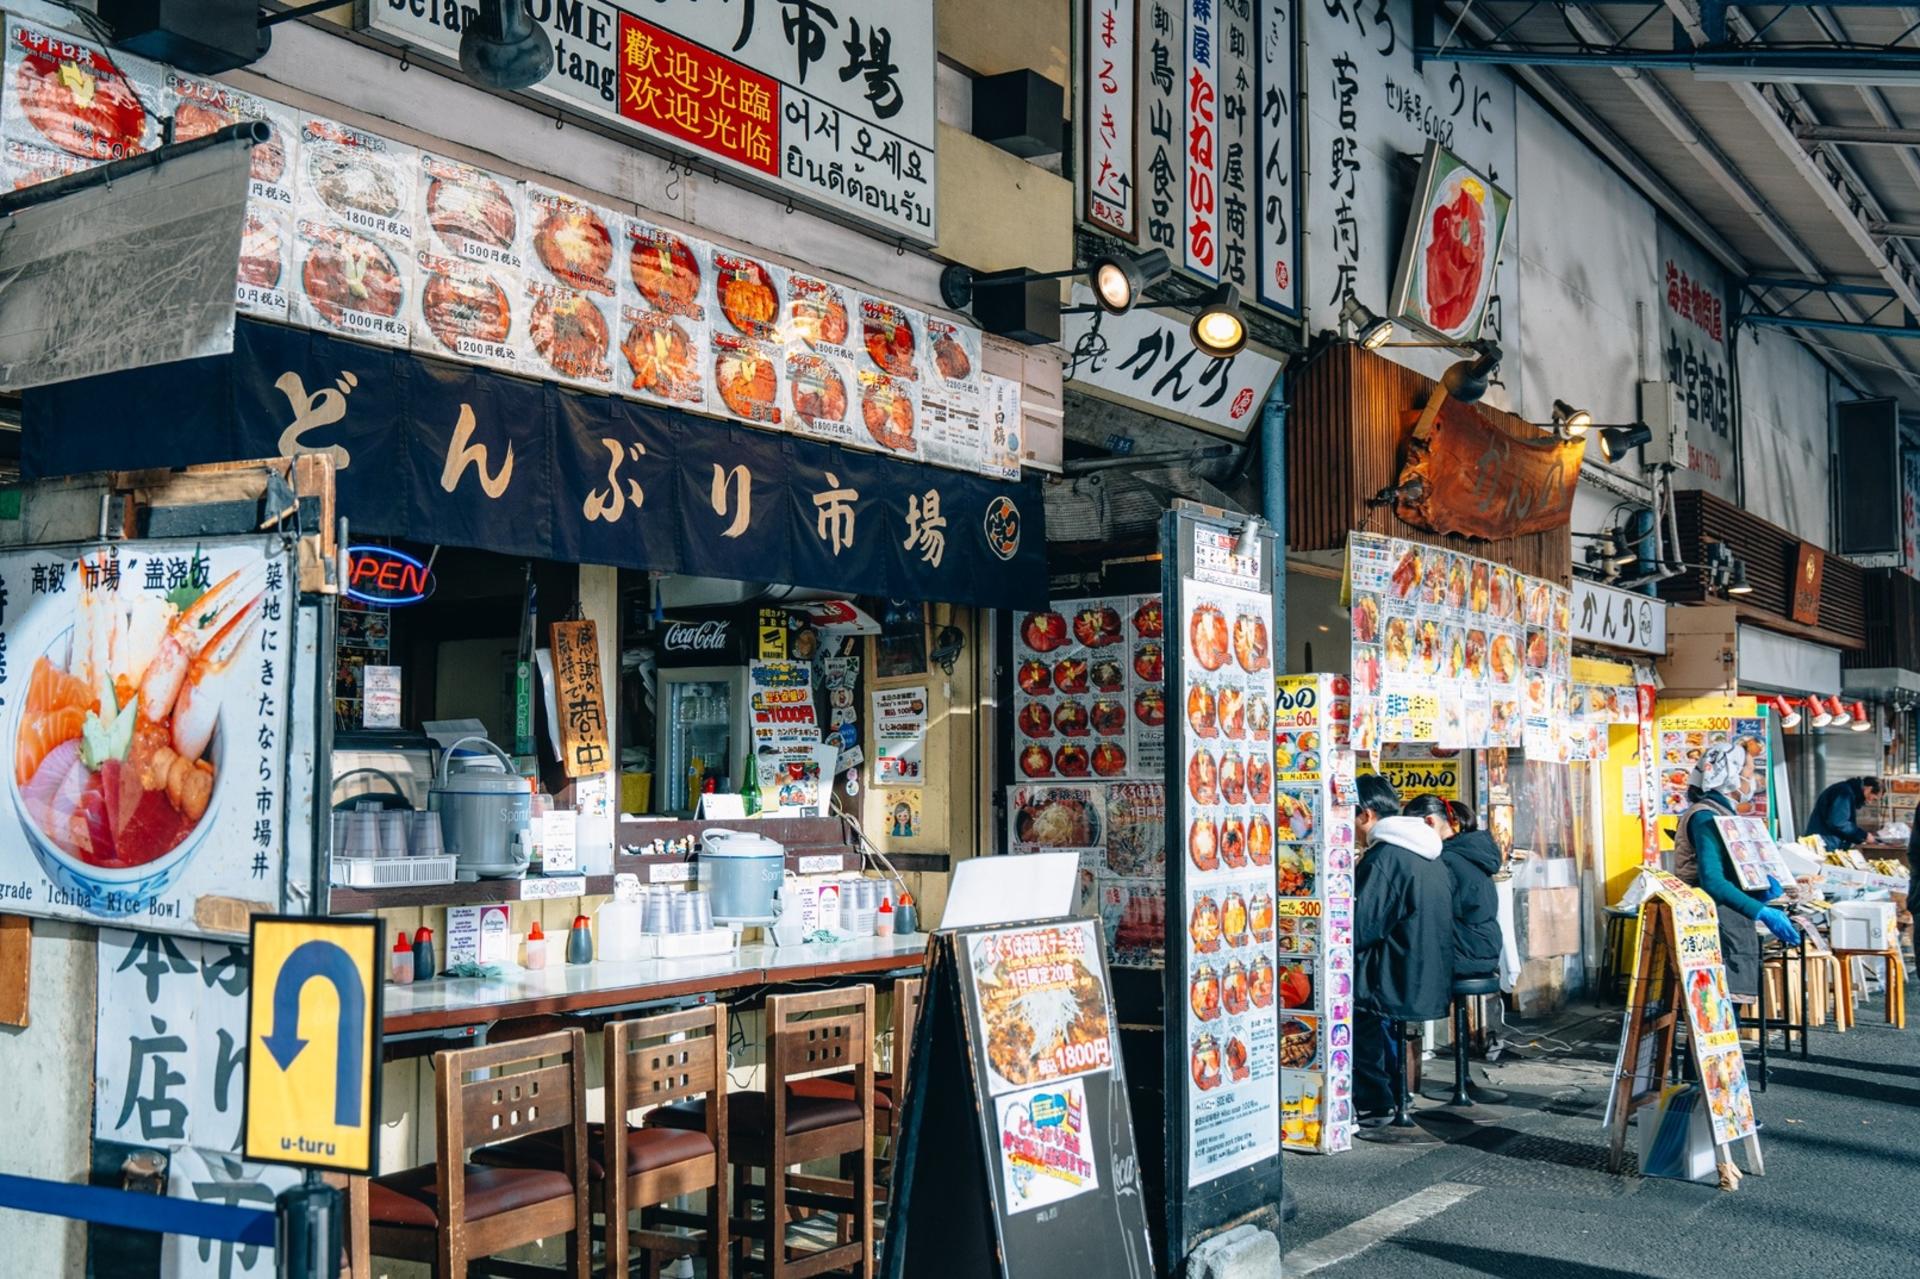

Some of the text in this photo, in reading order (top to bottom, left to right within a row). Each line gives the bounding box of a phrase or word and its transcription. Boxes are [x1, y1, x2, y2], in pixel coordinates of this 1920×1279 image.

[624, 27, 772, 124] 歡迎光臨
[1097, 8, 1120, 196] まるきた
[1448, 61, 1493, 134] うに
[624, 73, 772, 166] 欢迎光临
[785, 98, 927, 184] 어서 오세요
[786, 145, 932, 228] ยินดีต้อนรับ
[1189, 67, 1214, 267] たねいち
[1222, 94, 1247, 287] 叶屋商店
[1262, 84, 1288, 245] かんの
[346, 211, 412, 239] 1800円税込
[462, 241, 522, 269] 1500円税込
[342, 312, 408, 337] 1000円税込
[457, 339, 517, 361] 1200円税込
[1114, 326, 1236, 408] かんの
[275, 370, 948, 569] どんぶり市場
[664, 620, 730, 650] Coca-Cola
[1580, 589, 1637, 644] かんの
[107, 892, 141, 914] Rice
[149, 898, 181, 919] Bowl
[115, 932, 199, 1141] 本店
[1056, 1036, 1111, 1071] 1800円
[280, 1135, 336, 1156] u-turu
